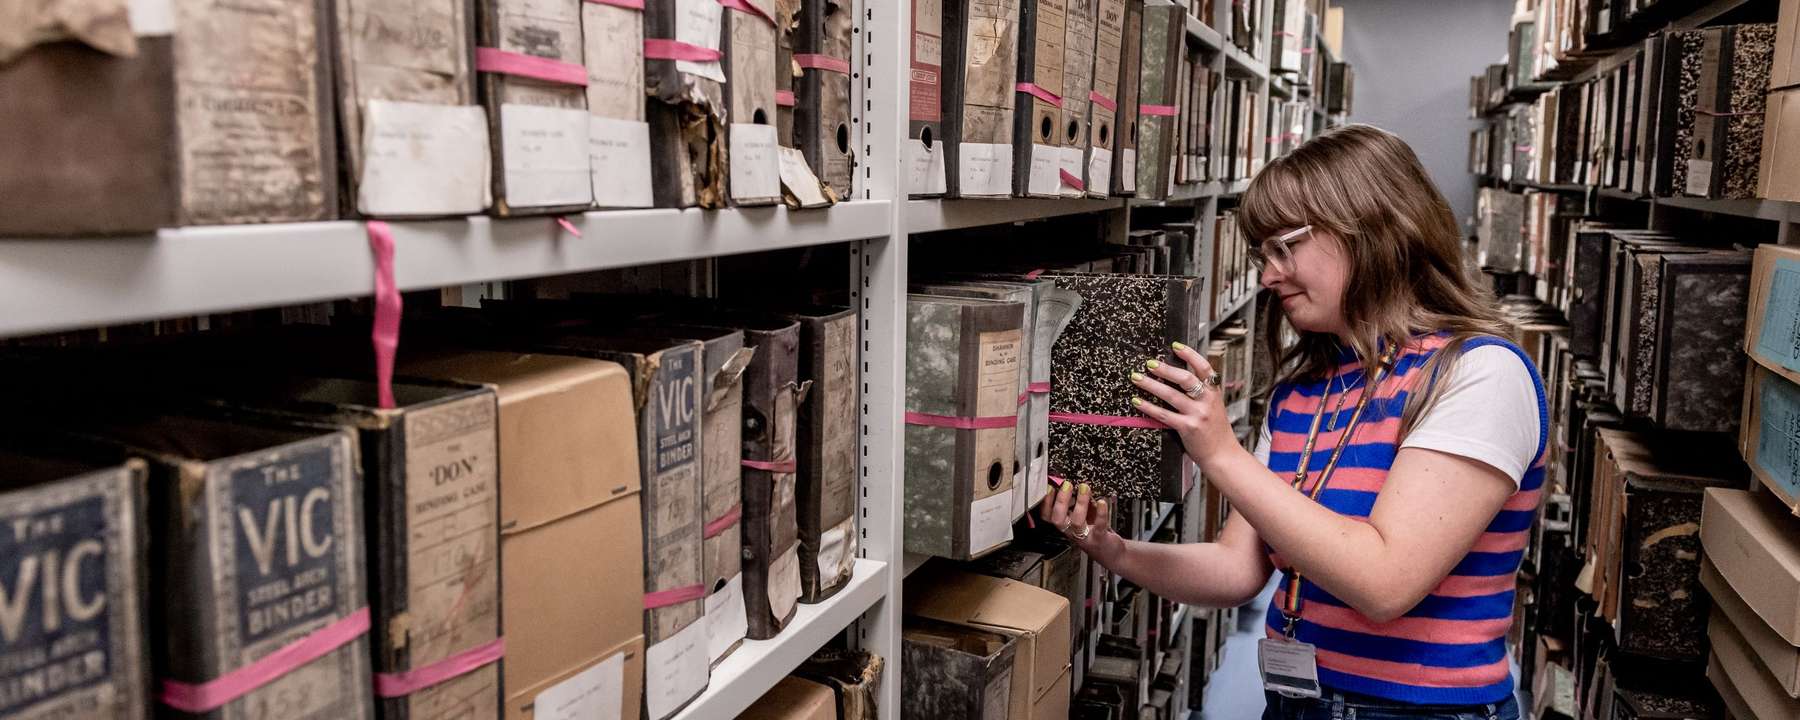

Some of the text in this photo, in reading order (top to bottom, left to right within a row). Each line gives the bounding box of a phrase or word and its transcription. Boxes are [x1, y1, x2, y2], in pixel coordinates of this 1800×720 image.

[659, 375, 693, 430] VIC
[260, 463, 300, 487] THE
[660, 442, 692, 468] BINDER
[237, 486, 333, 577] VIC
[248, 584, 332, 635] BINDER
